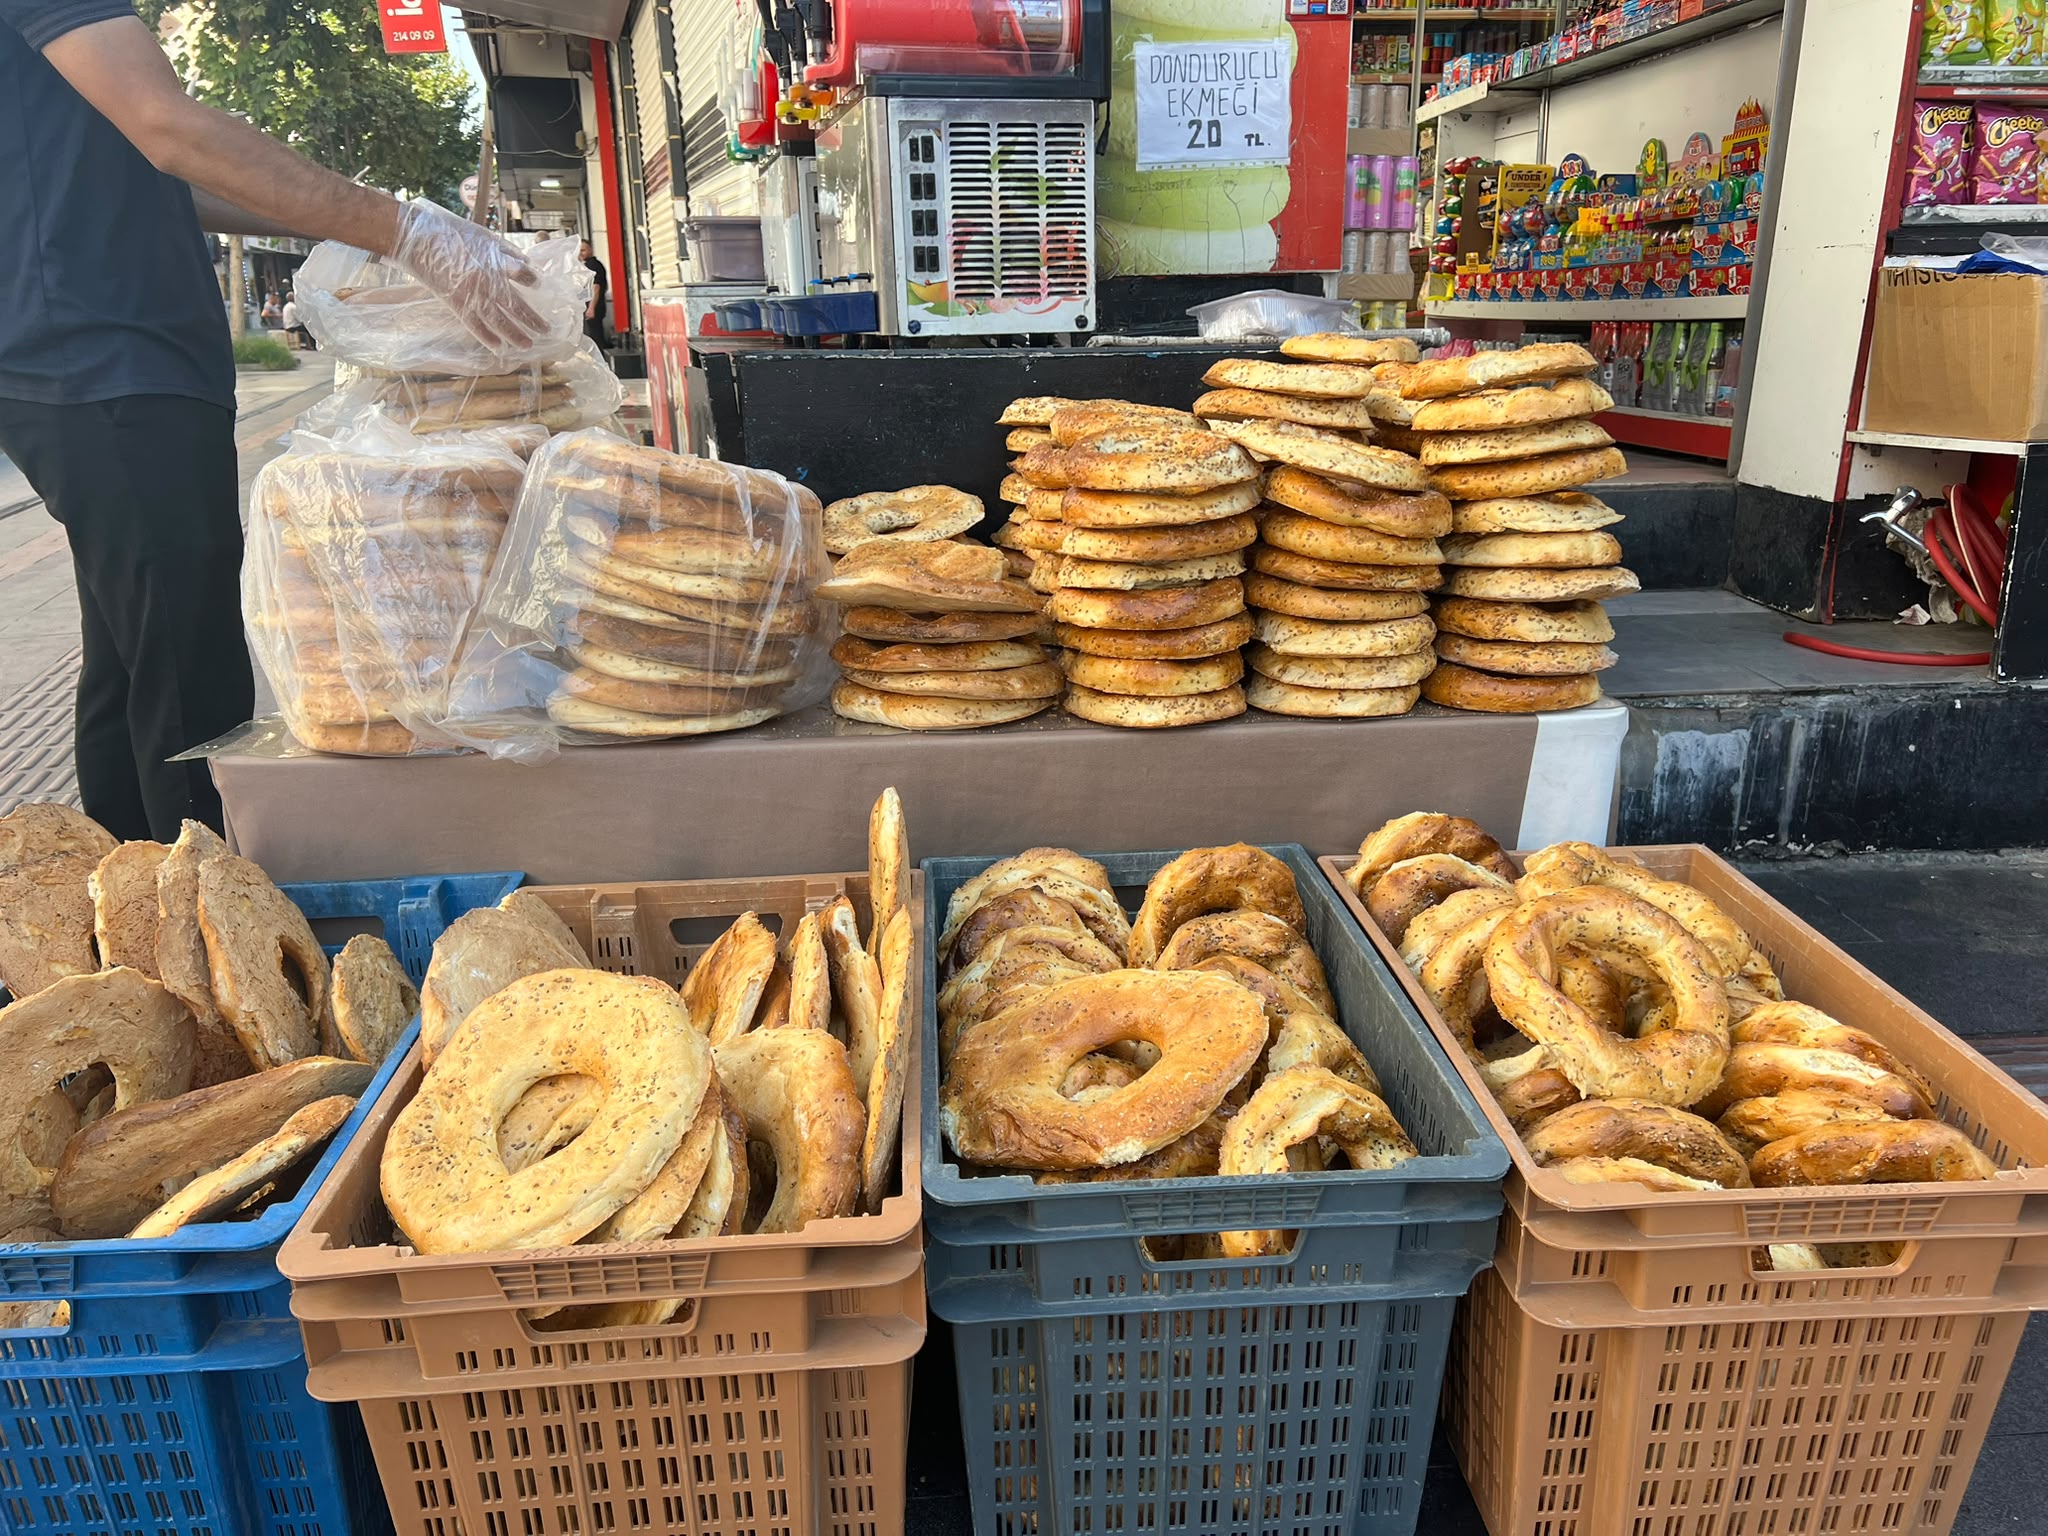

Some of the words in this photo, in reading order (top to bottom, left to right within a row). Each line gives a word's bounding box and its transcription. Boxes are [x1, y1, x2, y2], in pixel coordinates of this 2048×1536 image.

[393, 32, 408, 41] 214
[1150, 50, 1278, 84] DONDURUCU
[1167, 82, 1258, 118] EKMEĞİ
[1187, 119, 1222, 149] 20
[1511, 173, 1541, 182] UNDER
